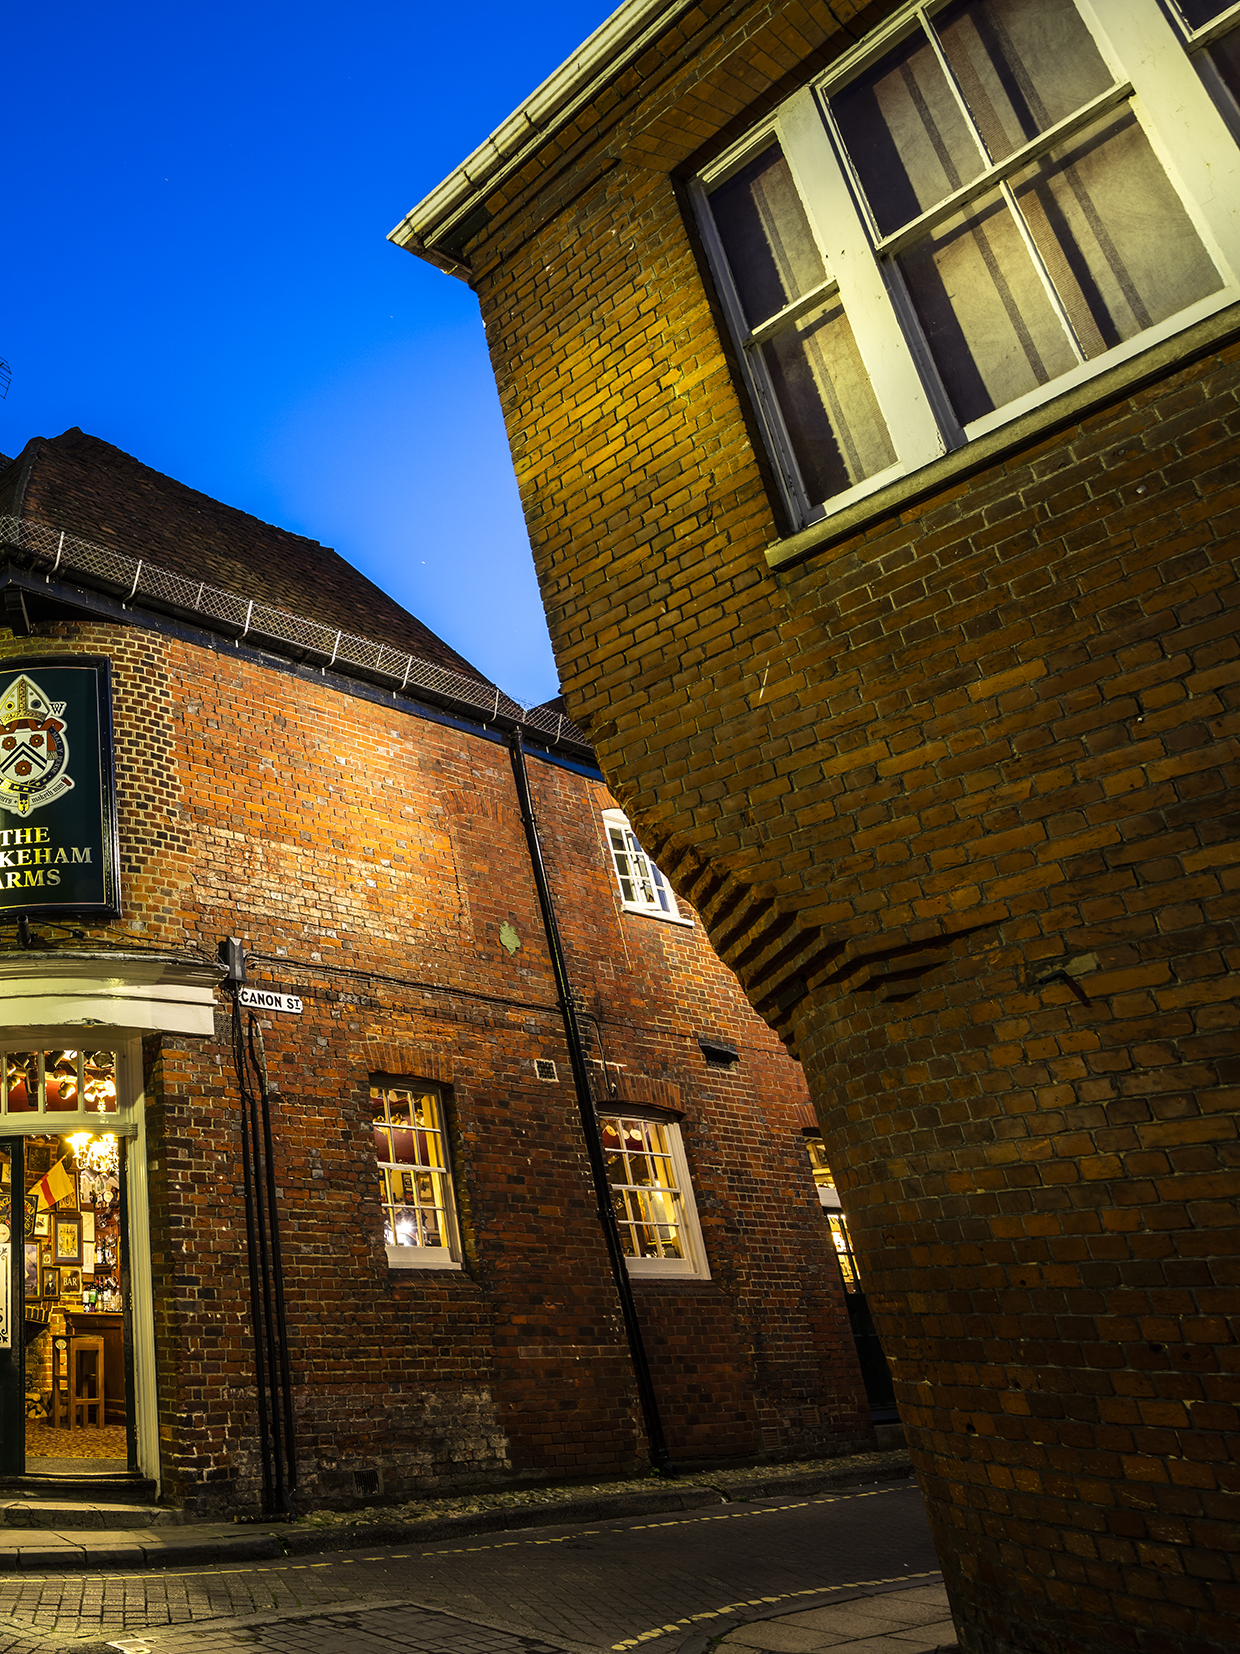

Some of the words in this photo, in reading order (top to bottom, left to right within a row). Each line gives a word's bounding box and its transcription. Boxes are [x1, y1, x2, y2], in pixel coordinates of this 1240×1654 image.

[50, 703, 65, 714] W
[241, 991, 282, 1008] CANON
[63, 1277, 78, 1286] BAR
